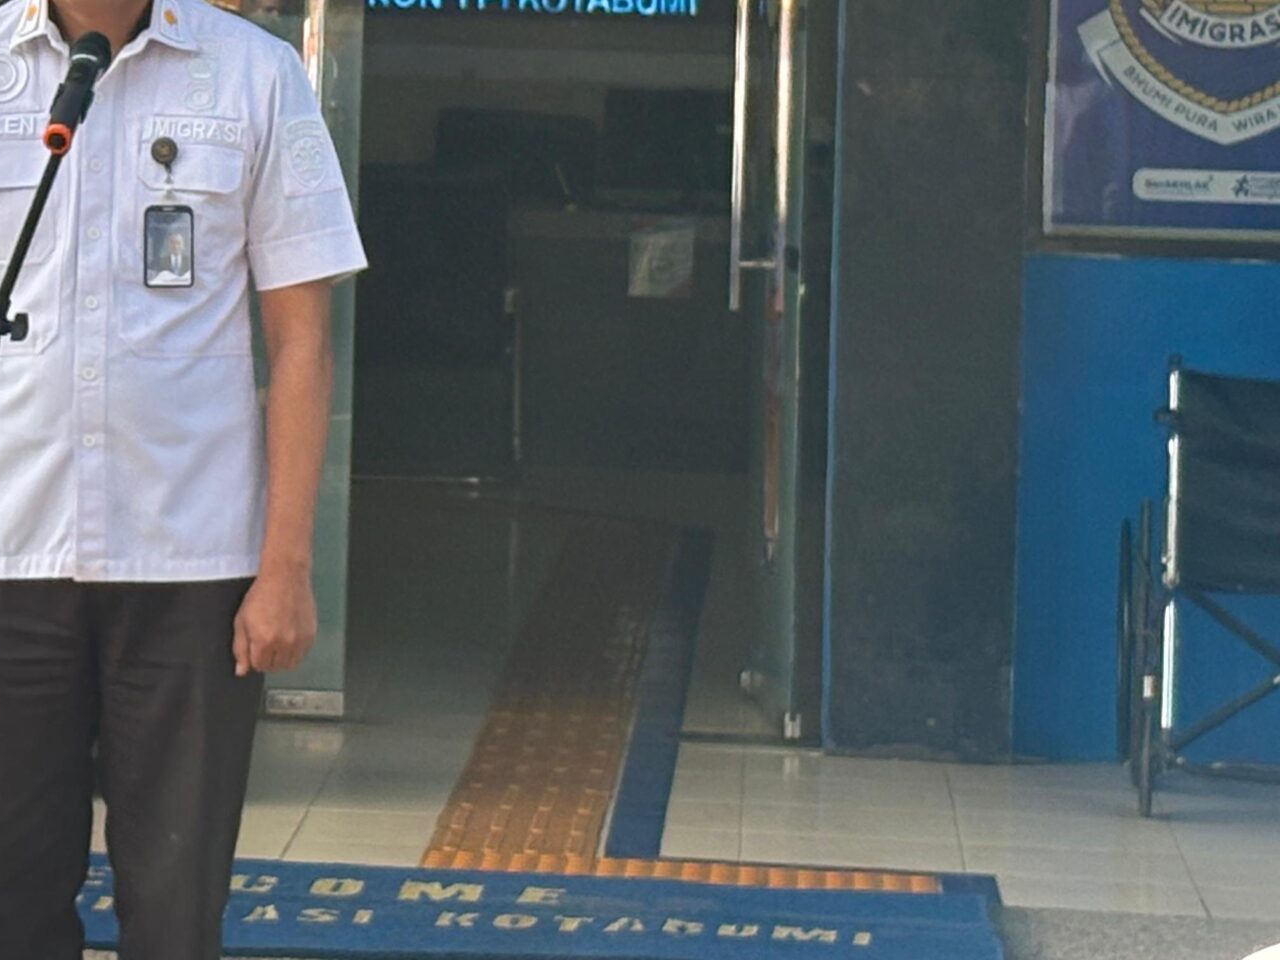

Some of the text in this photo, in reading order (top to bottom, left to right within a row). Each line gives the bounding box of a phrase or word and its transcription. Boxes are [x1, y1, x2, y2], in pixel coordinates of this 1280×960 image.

[152, 119, 242, 143] IMIGRASI
[1174, 103, 1218, 133] PURA
[434, 911, 874, 946] KOTABUMI
